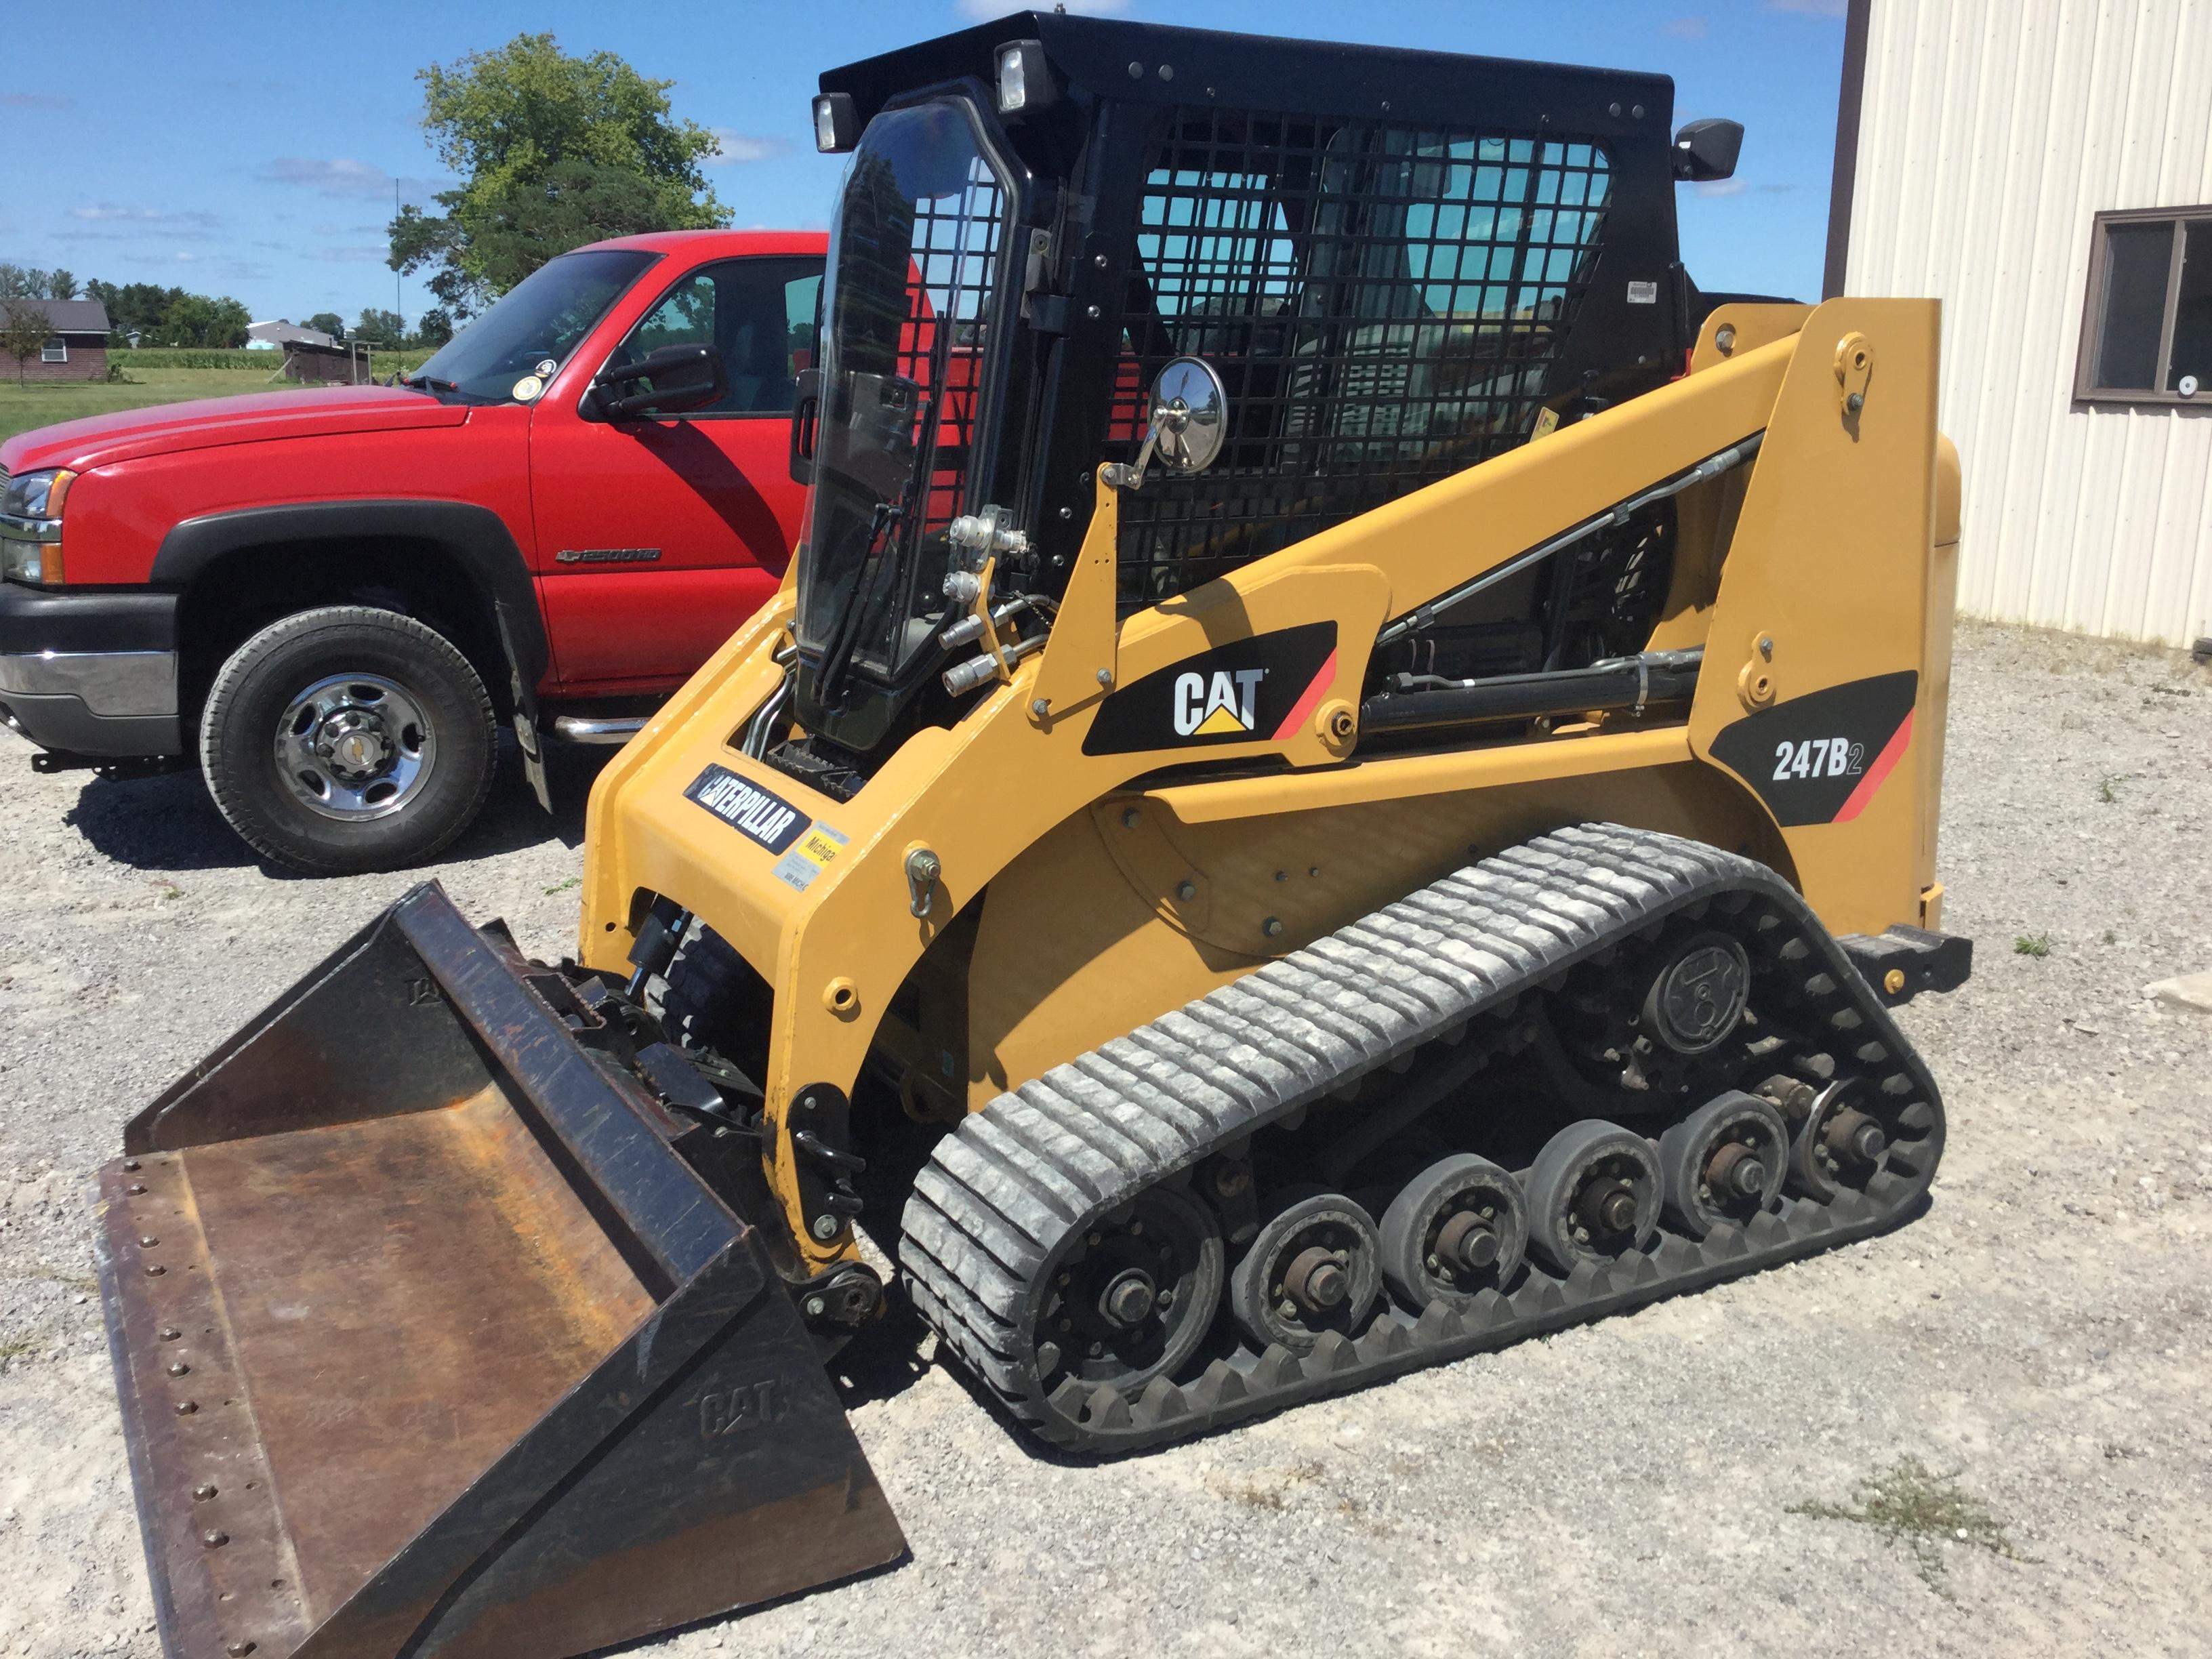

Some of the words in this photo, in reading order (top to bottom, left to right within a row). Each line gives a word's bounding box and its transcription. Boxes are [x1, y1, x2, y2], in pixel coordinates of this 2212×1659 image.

[1174, 669, 1264, 735] CAT
[1773, 737, 1864, 781] 247B2
[697, 774, 796, 844] CATERPILLAR
[701, 1379, 777, 1437] CAT
